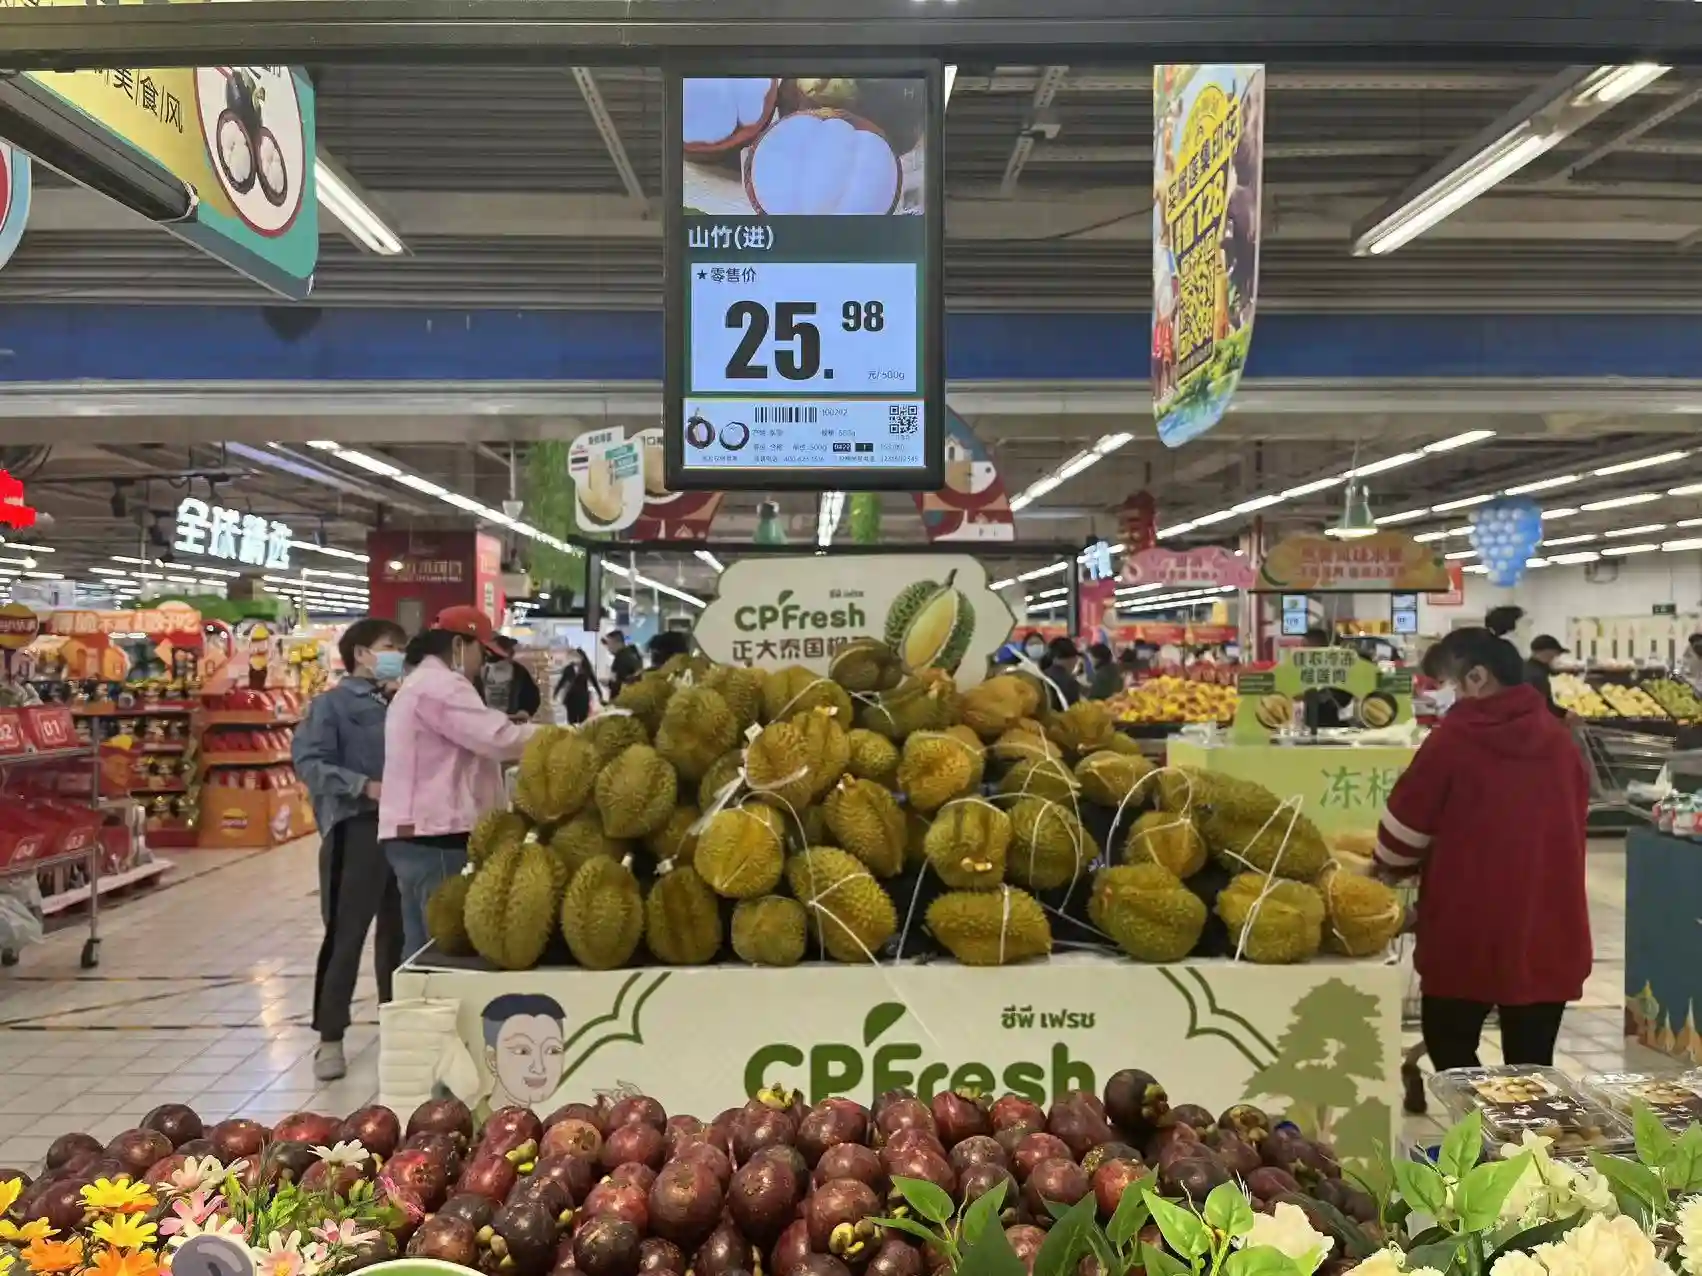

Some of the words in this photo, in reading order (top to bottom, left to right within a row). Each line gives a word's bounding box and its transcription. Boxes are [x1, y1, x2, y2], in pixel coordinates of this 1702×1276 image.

[688, 224, 774, 250] 山竹(进)
[710, 267, 757, 283] 零售价
[734, 601, 865, 632] CPFresh
[43, 719, 61, 737] 01
